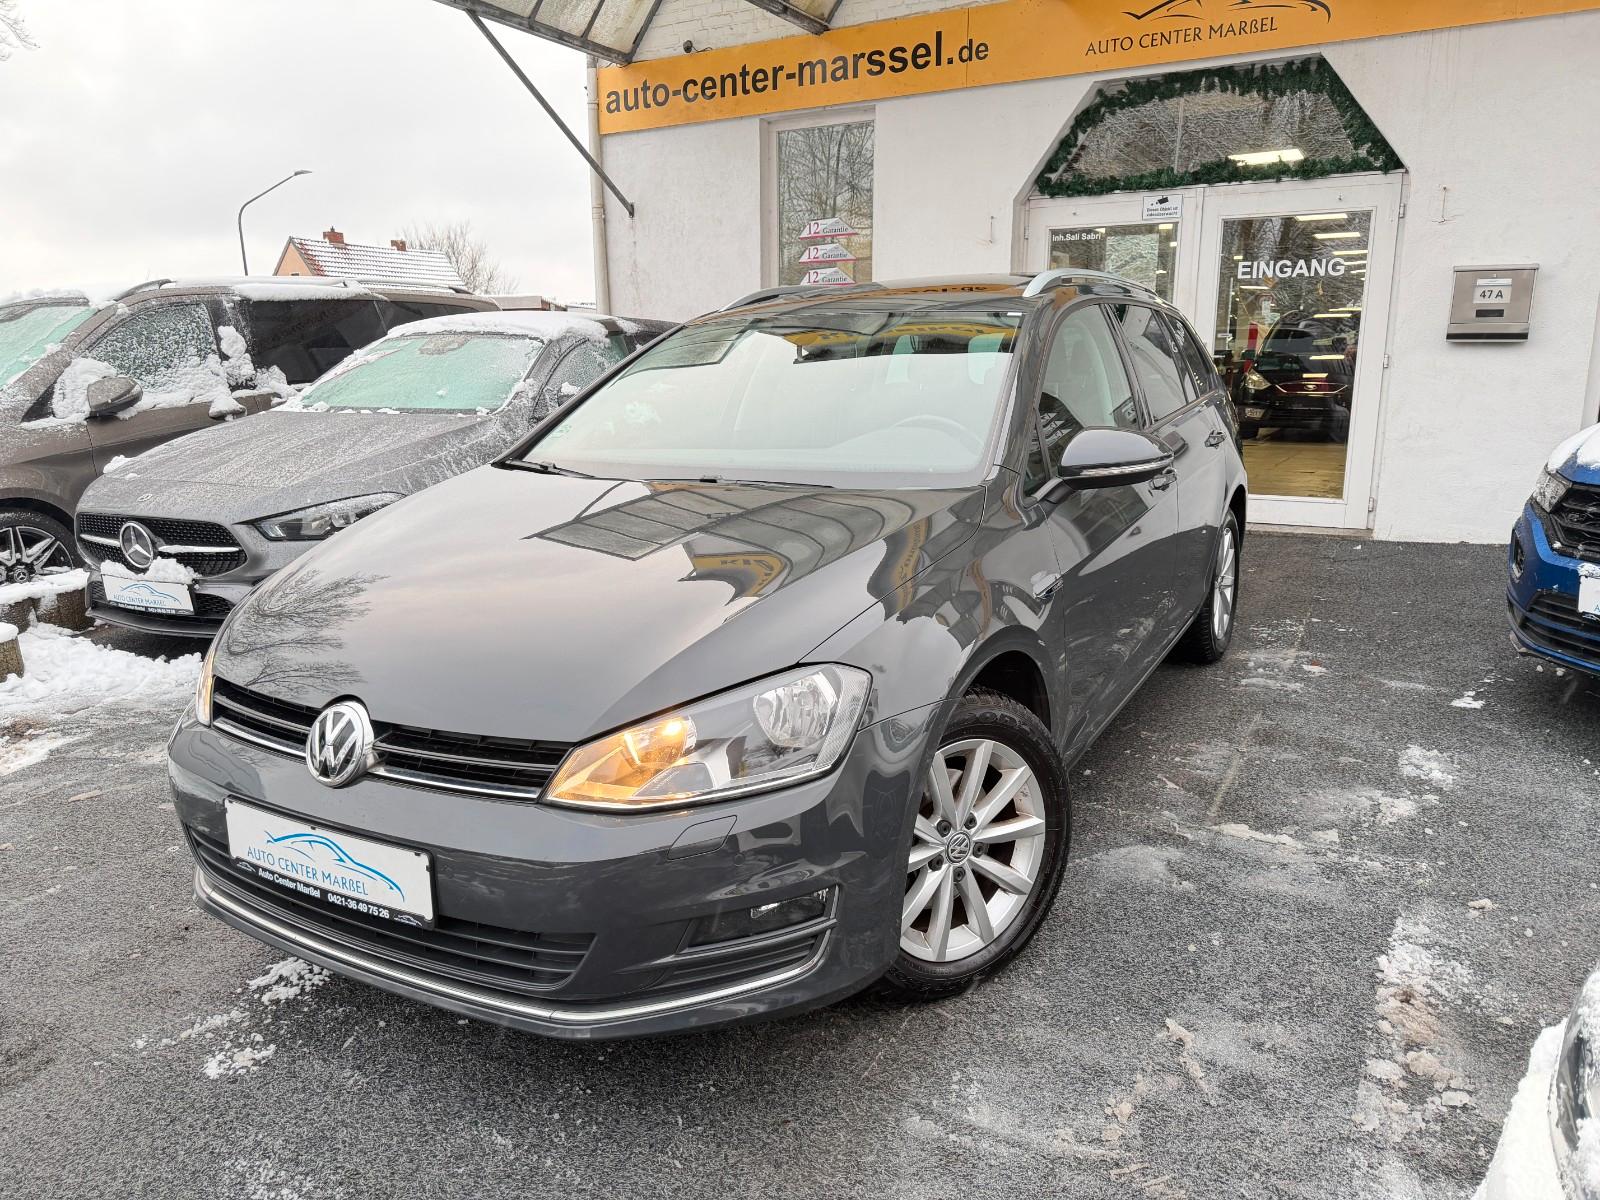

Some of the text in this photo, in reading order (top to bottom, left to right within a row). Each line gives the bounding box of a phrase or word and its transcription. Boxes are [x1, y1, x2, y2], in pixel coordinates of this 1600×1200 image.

[1085, 36, 1134, 56] AUTO
[1138, 26, 1202, 49] CENTER
[606, 31, 989, 113] auto-center-marssel.de
[807, 222, 820, 235] 12
[807, 247, 820, 260] 12
[807, 271, 820, 284] 12
[1237, 257, 1345, 279] EINGANG
[1480, 289, 1493, 299] 47
[247, 846, 275, 866] AUTO
[278, 857, 318, 881] CENTER
[258, 868, 273, 881] Auto
[274, 874, 296, 889] Center
